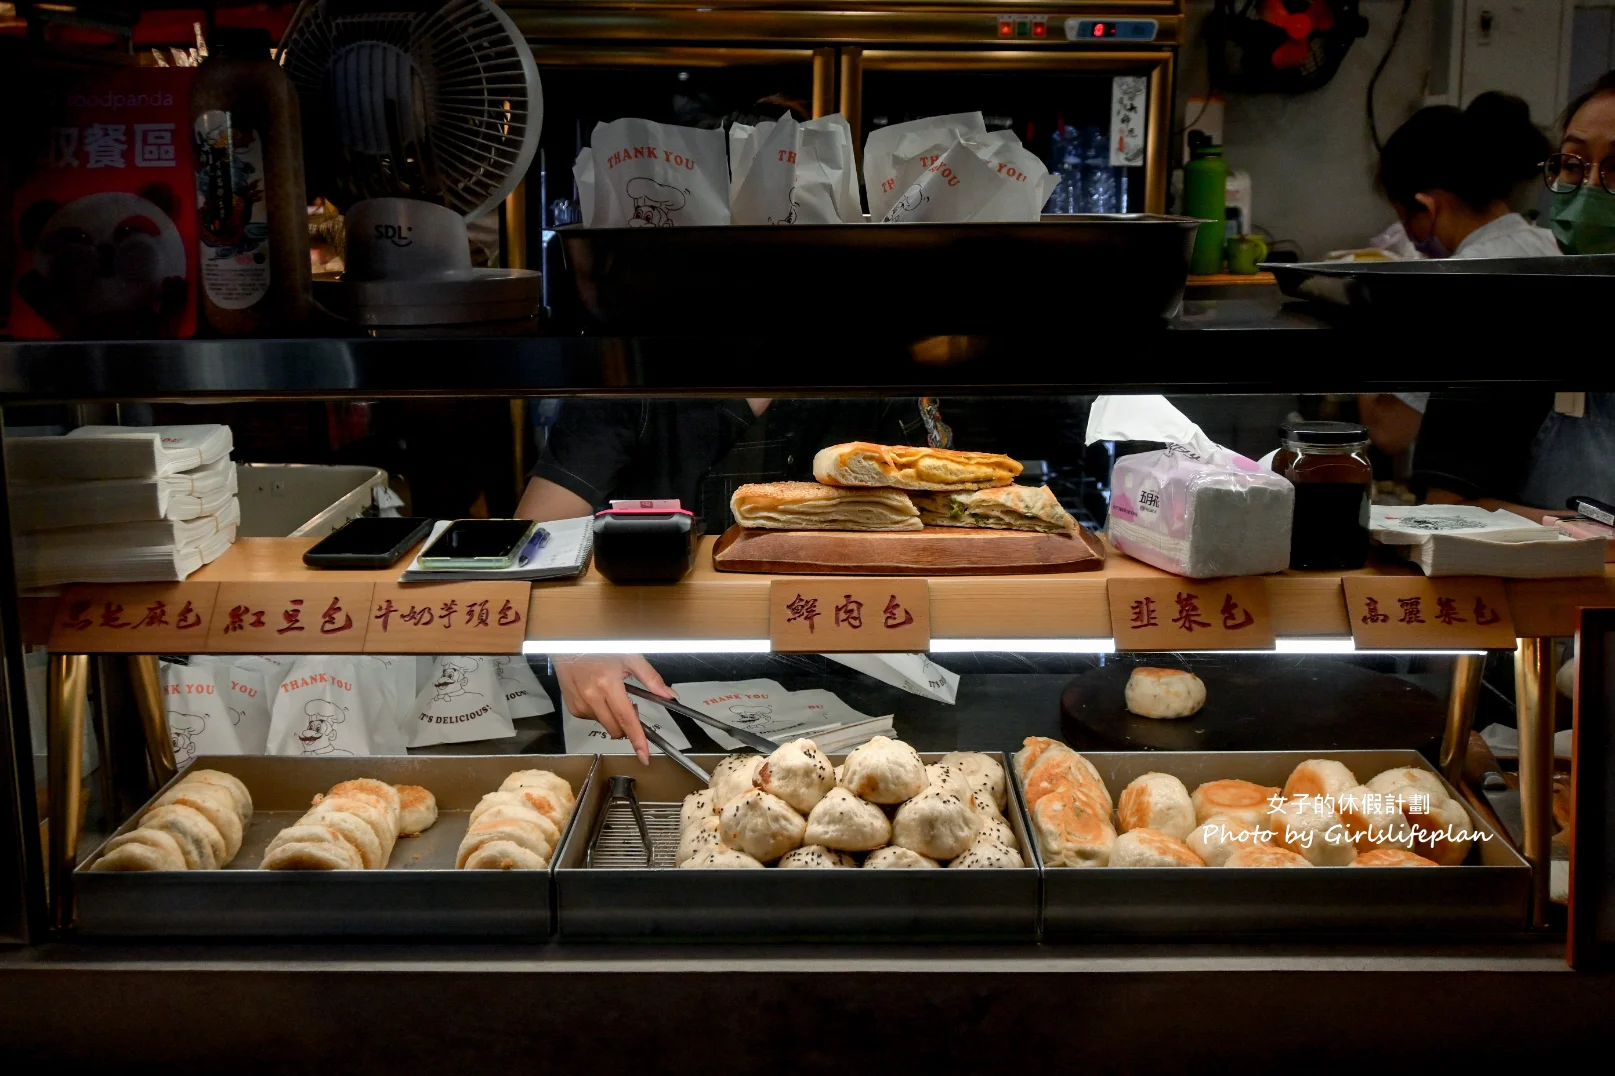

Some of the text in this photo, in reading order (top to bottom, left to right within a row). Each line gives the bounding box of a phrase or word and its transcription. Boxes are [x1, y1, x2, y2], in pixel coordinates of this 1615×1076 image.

[607, 147, 695, 170] THANK YOU
[223, 596, 353, 635] 紅豆包
[374, 599, 521, 633] 牛奶芋頭包
[786, 593, 914, 634] 鮮肉包
[1130, 591, 1255, 632] 韭菜包
[1361, 596, 1501, 626] 高麗菜包
[186, 683, 216, 695] YOU
[231, 680, 259, 698] YOU
[280, 672, 352, 693] THANK YOU
[702, 693, 742, 706] THANK
